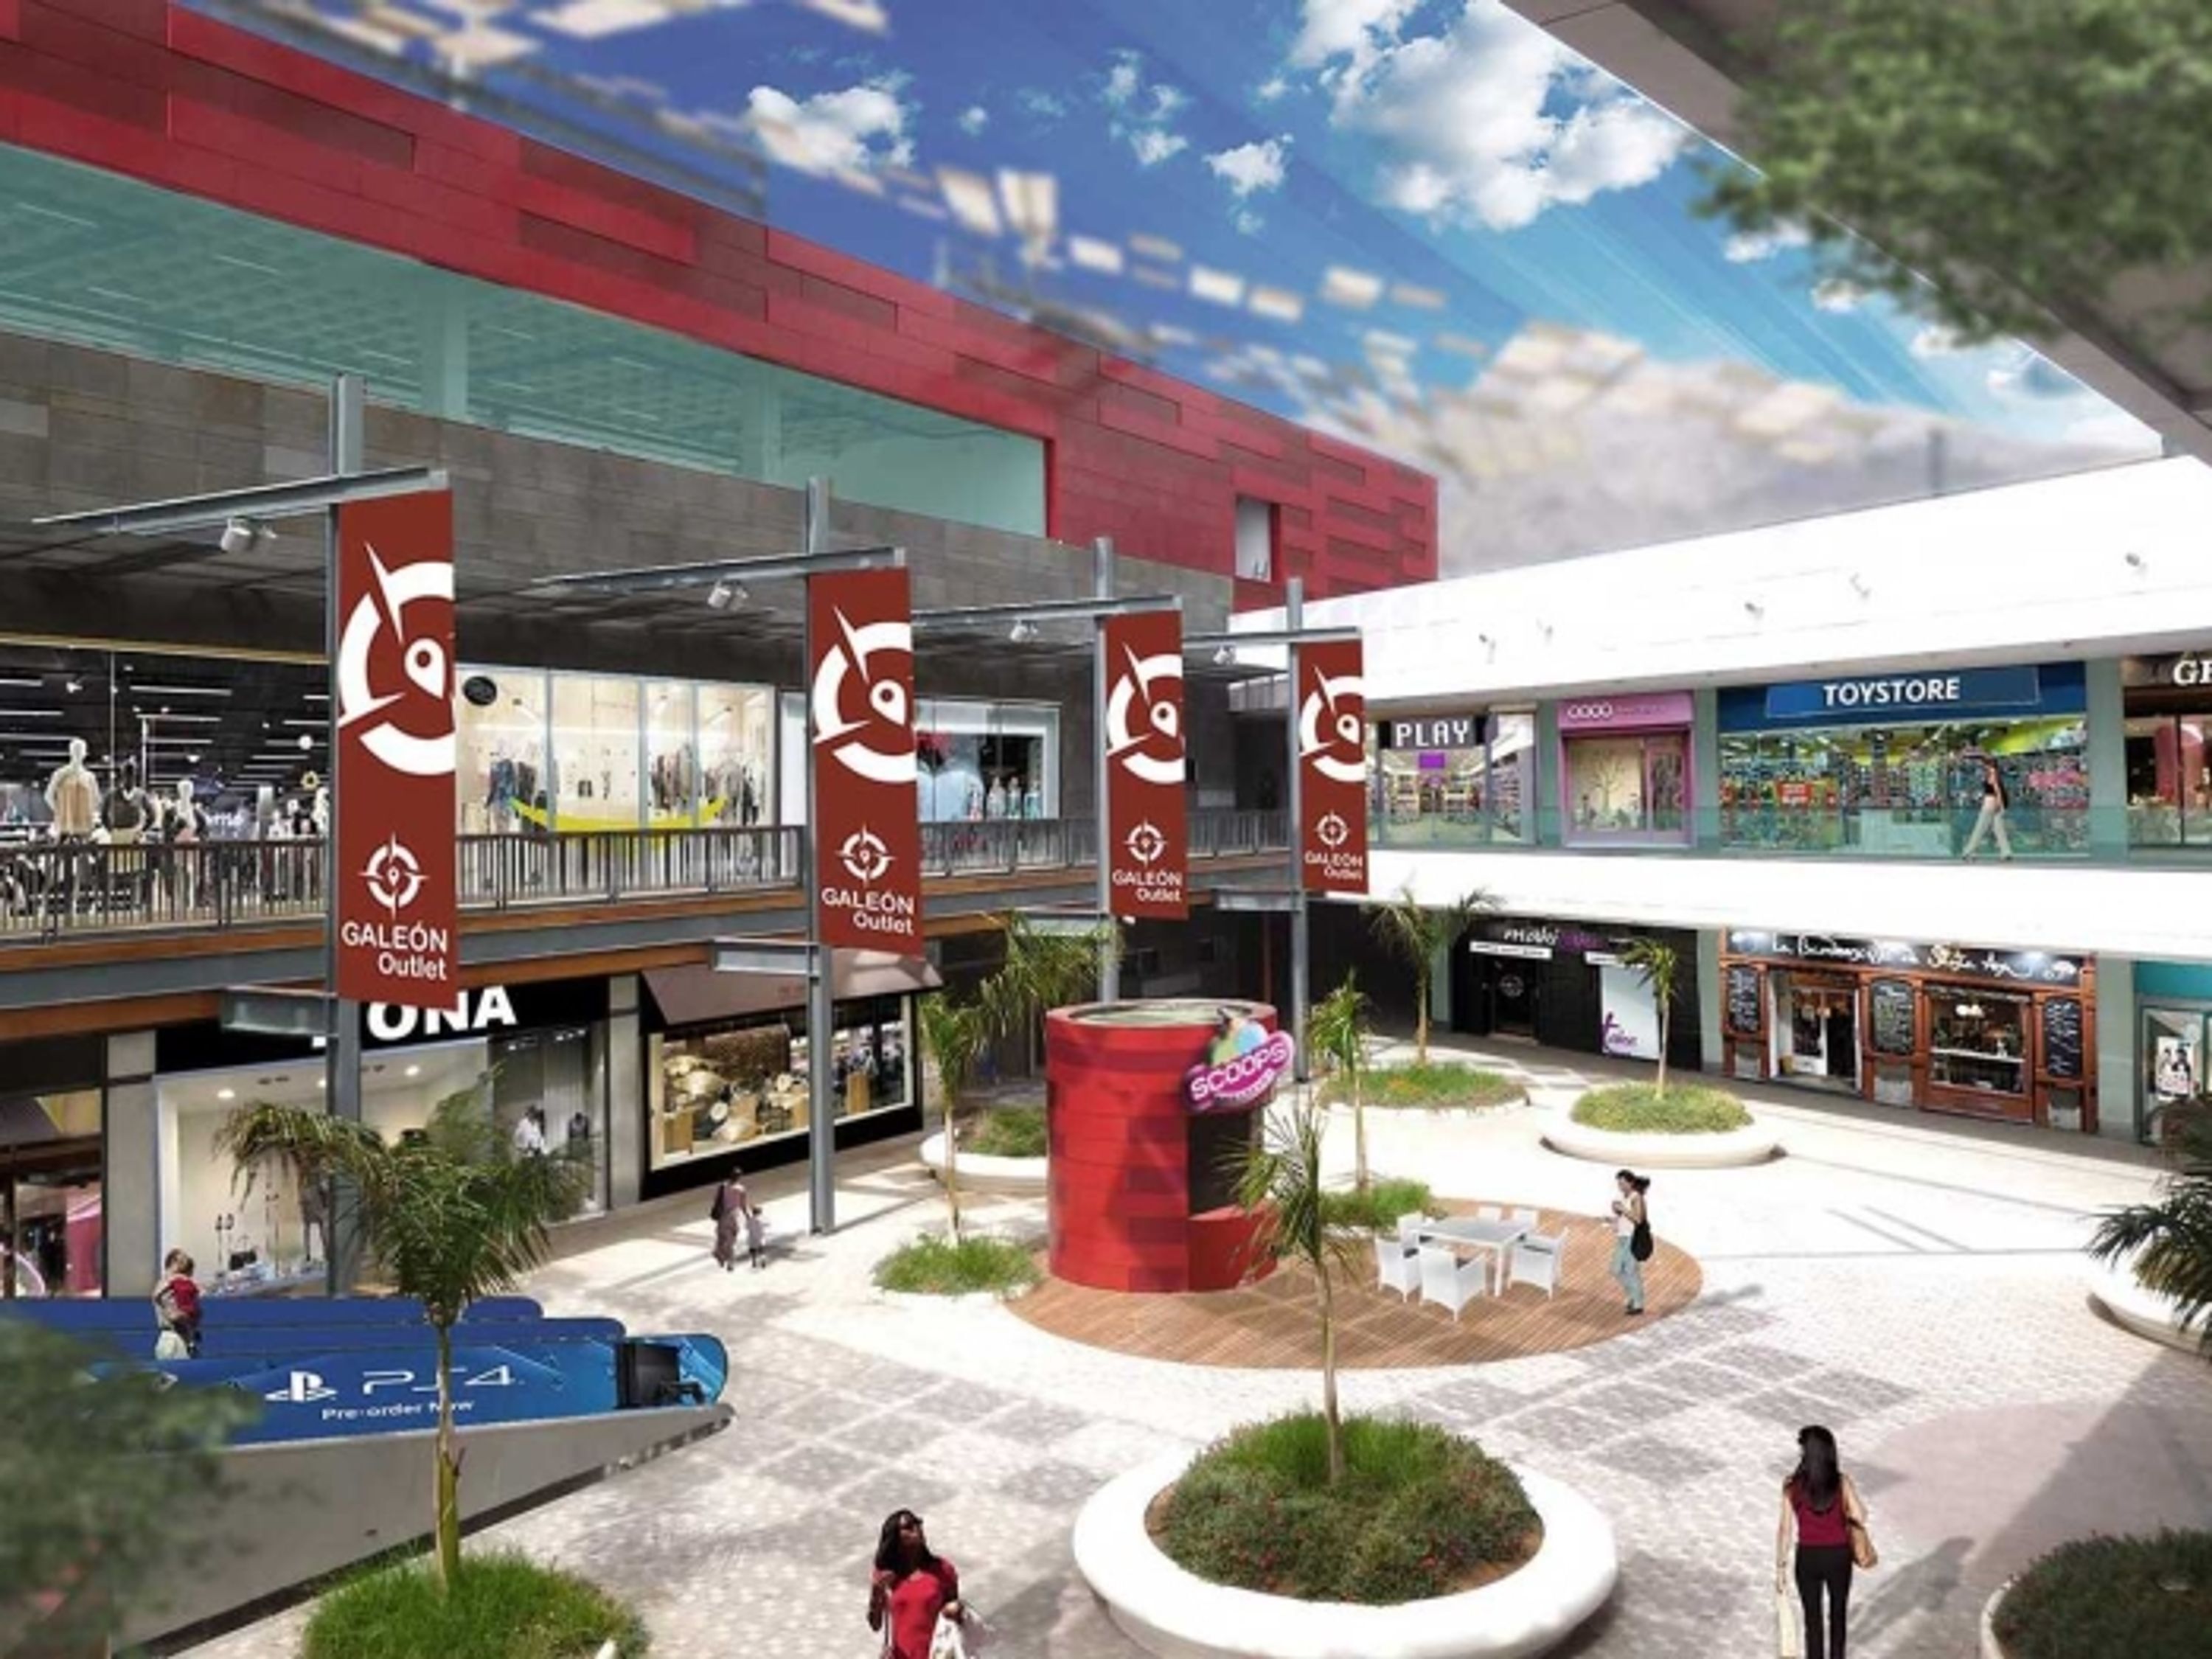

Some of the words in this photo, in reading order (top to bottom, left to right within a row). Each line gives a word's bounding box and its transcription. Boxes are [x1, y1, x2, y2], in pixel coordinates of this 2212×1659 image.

[1823, 676, 1961, 706] TOYSTORE
[1396, 720, 1469, 747] PLAY
[821, 887, 915, 915] GALEÓN
[341, 920, 448, 953] GALEÓN
[852, 910, 914, 936] Outlet
[378, 950, 447, 981] Outlet
[312, 985, 518, 1048] ONA
[1190, 1042, 1287, 1101] SCOOPS
[362, 1365, 510, 1396] PS4
[321, 1403, 422, 1421] Pre-order
